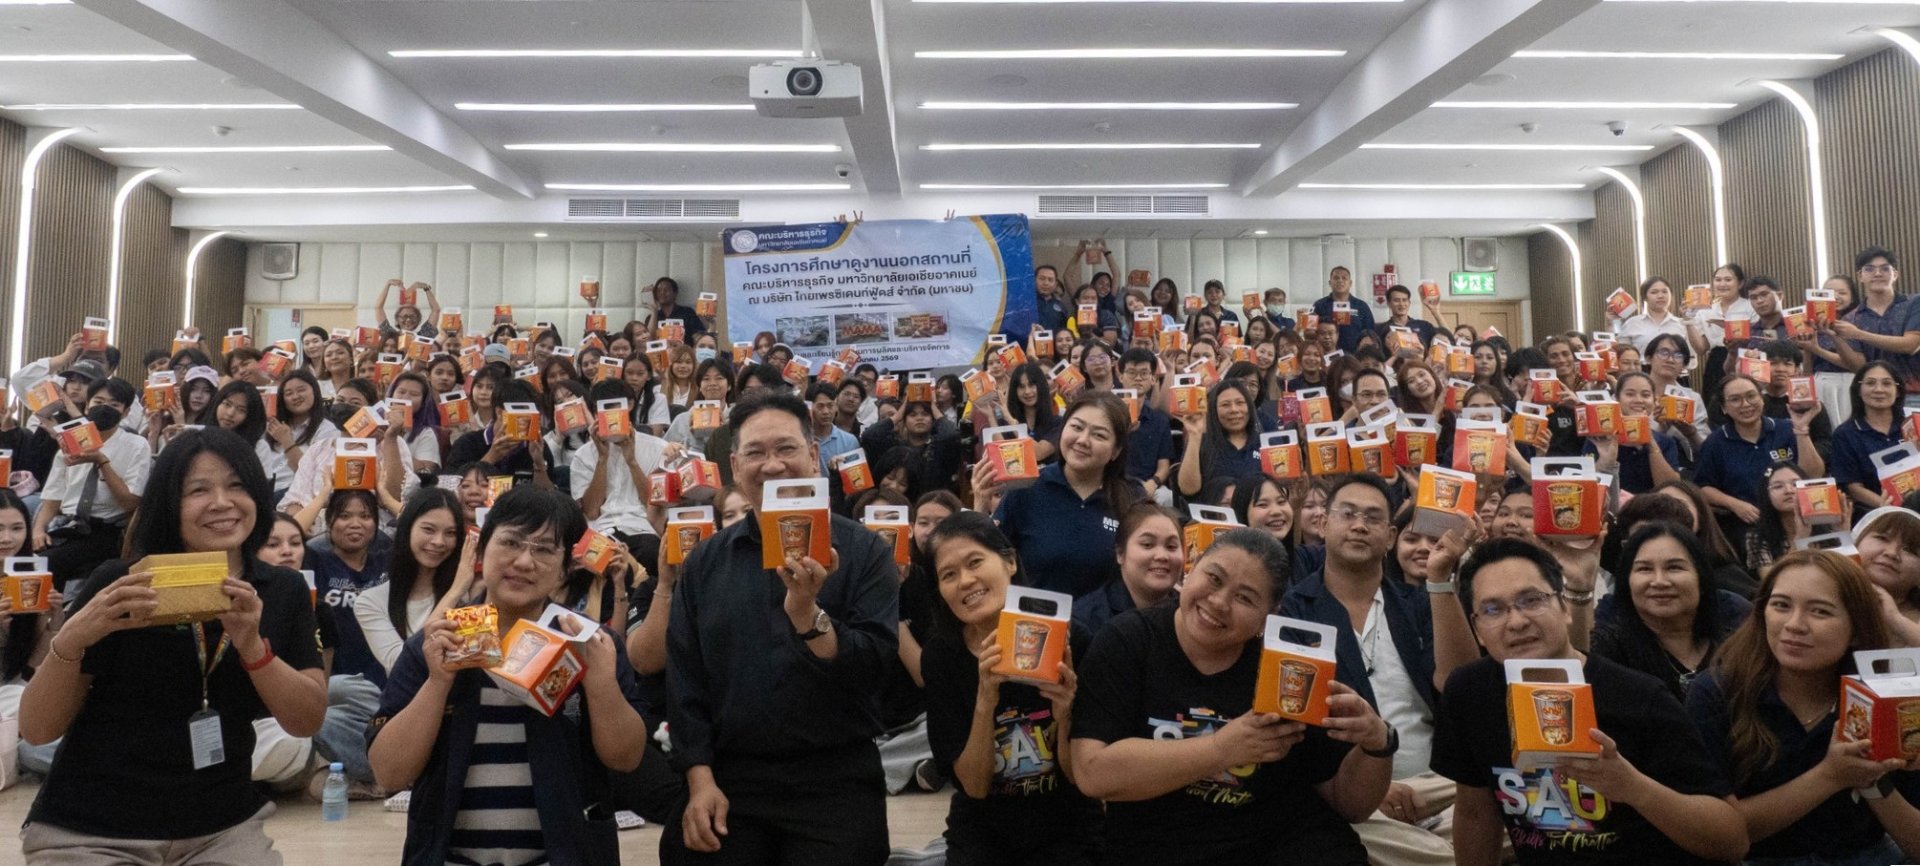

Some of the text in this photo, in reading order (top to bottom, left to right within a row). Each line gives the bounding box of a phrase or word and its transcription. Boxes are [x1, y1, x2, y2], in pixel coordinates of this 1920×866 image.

[758, 228, 827, 240] คณะบริหารธุรกิจ
[745, 244, 972, 275] โครงการศึกษาดูงานนอกสถานที่
[742, 267, 977, 291] คณะบริหารธุรกิจ มหาวิทยาลัยเอเชียอาคเนย์
[748, 296, 760, 305] ณ
[763, 291, 793, 304] บริษัท
[897, 284, 926, 297] จำกัด
[929, 283, 974, 296] (มหาชน)
[324, 589, 358, 608] GR
[1498, 769, 1607, 821] SAU
